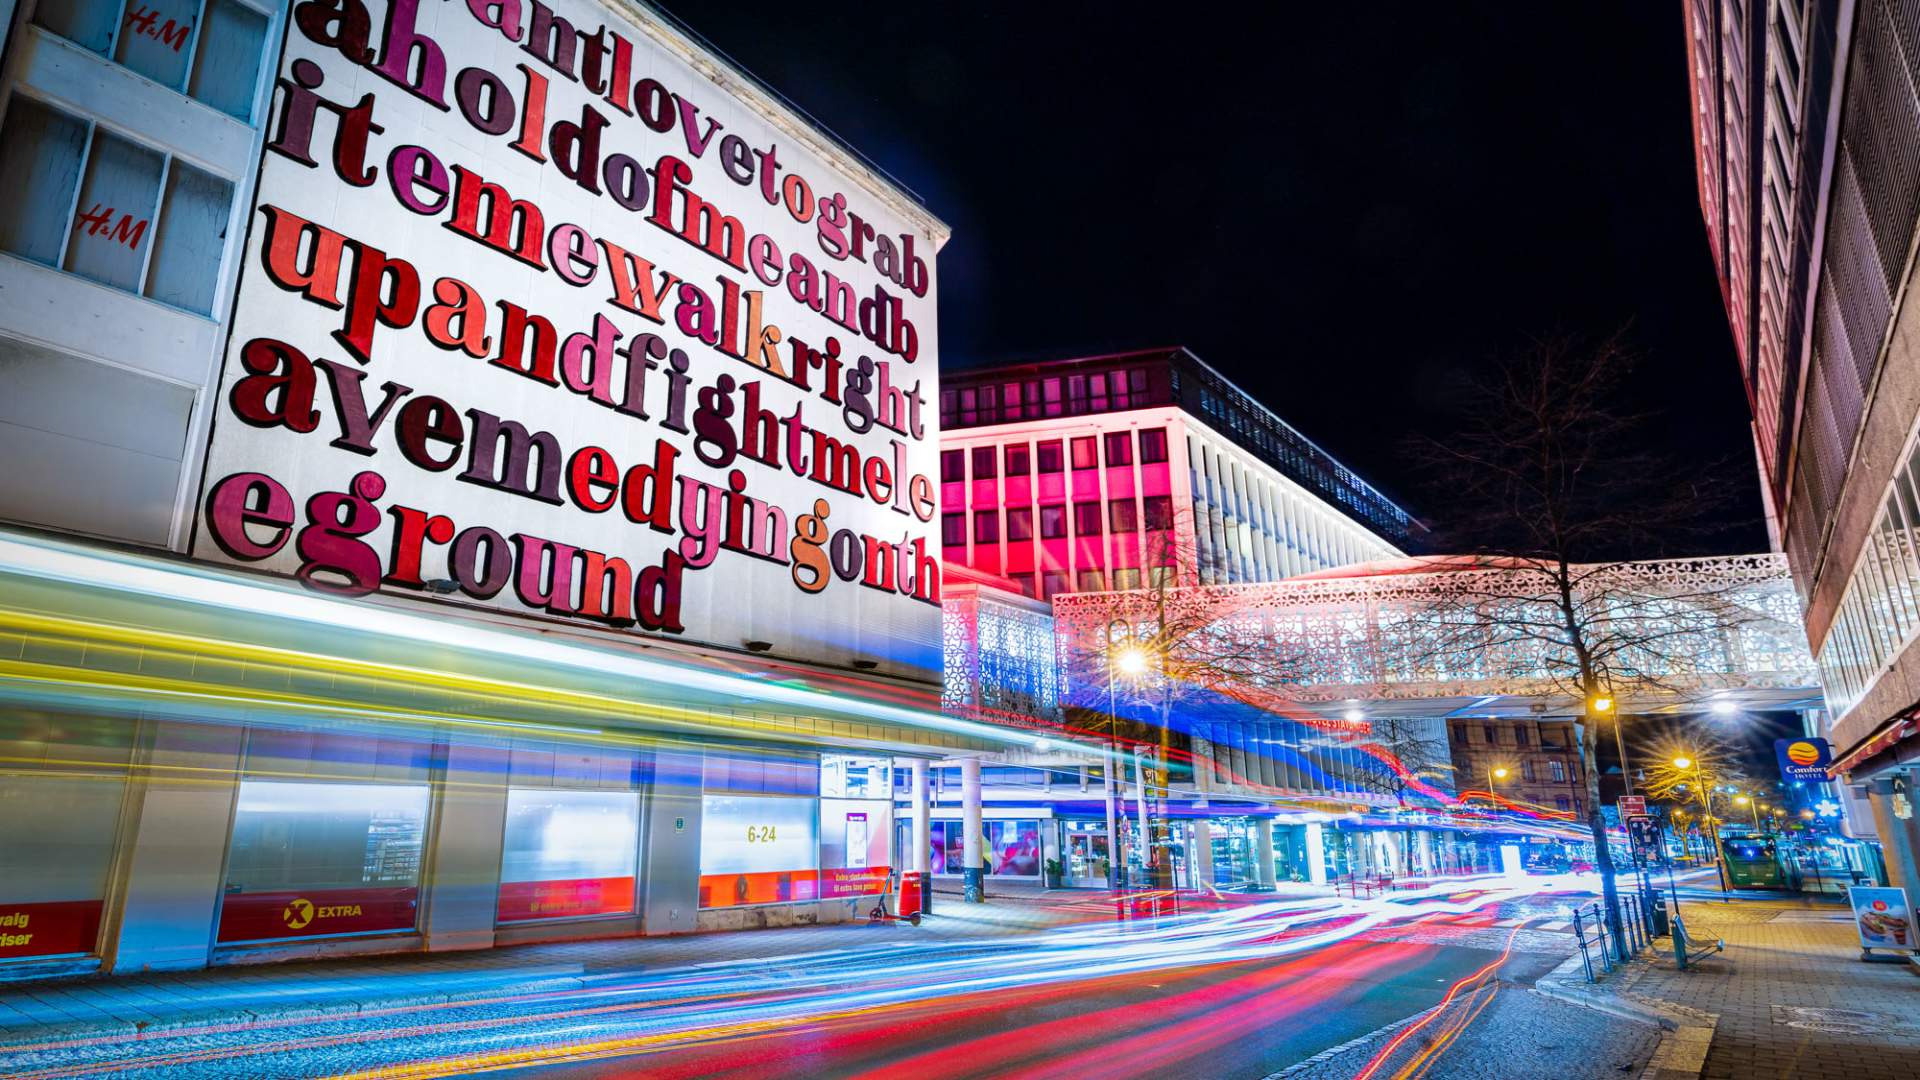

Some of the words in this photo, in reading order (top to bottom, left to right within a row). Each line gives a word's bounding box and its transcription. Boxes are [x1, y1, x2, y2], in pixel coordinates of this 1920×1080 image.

[127, 5, 190, 52] H&M
[443, 0, 929, 298] antlovetograb
[76, 203, 149, 250] H&M
[266, 58, 926, 440] itemewalkright
[258, 204, 936, 522] upandfightmele
[229, 337, 943, 608] avemedyingonth
[204, 470, 687, 634] eground
[1786, 765, 1828, 773] Comfort
[748, 825, 777, 842] 6-24
[317, 905, 362, 918] EXTRA
[0, 933, 33, 948] iser
